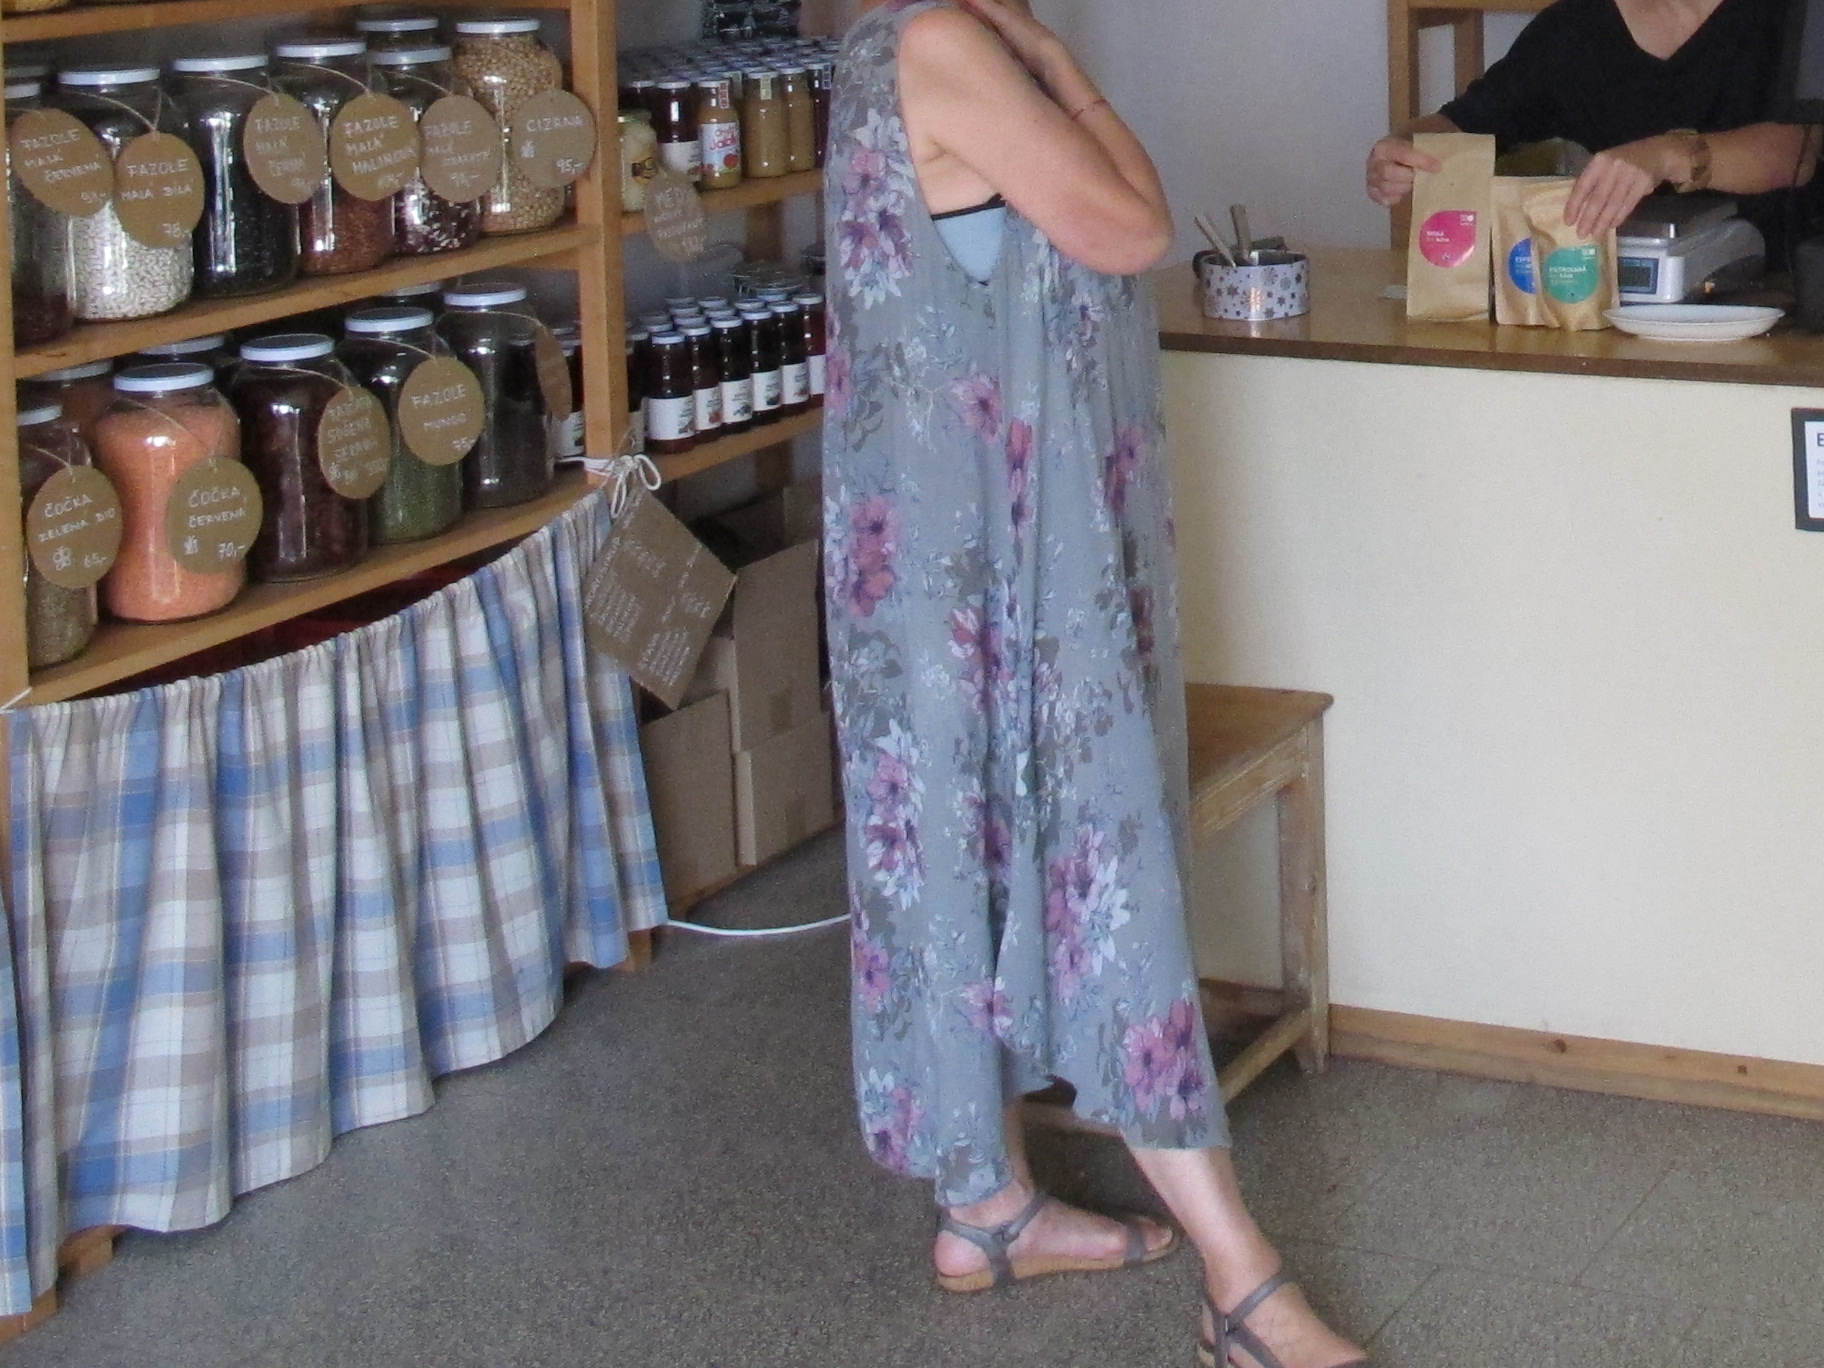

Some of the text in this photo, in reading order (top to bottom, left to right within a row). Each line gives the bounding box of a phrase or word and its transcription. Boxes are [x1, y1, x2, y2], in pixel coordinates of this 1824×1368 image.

[526, 115, 584, 132] CIZRNA
[20, 129, 81, 151] FAZOLE
[126, 158, 190, 178] FAZOLE
[411, 384, 467, 409] FAZOLE
[44, 494, 94, 519] ČOČKA
[188, 487, 242, 509] ČOČKA
